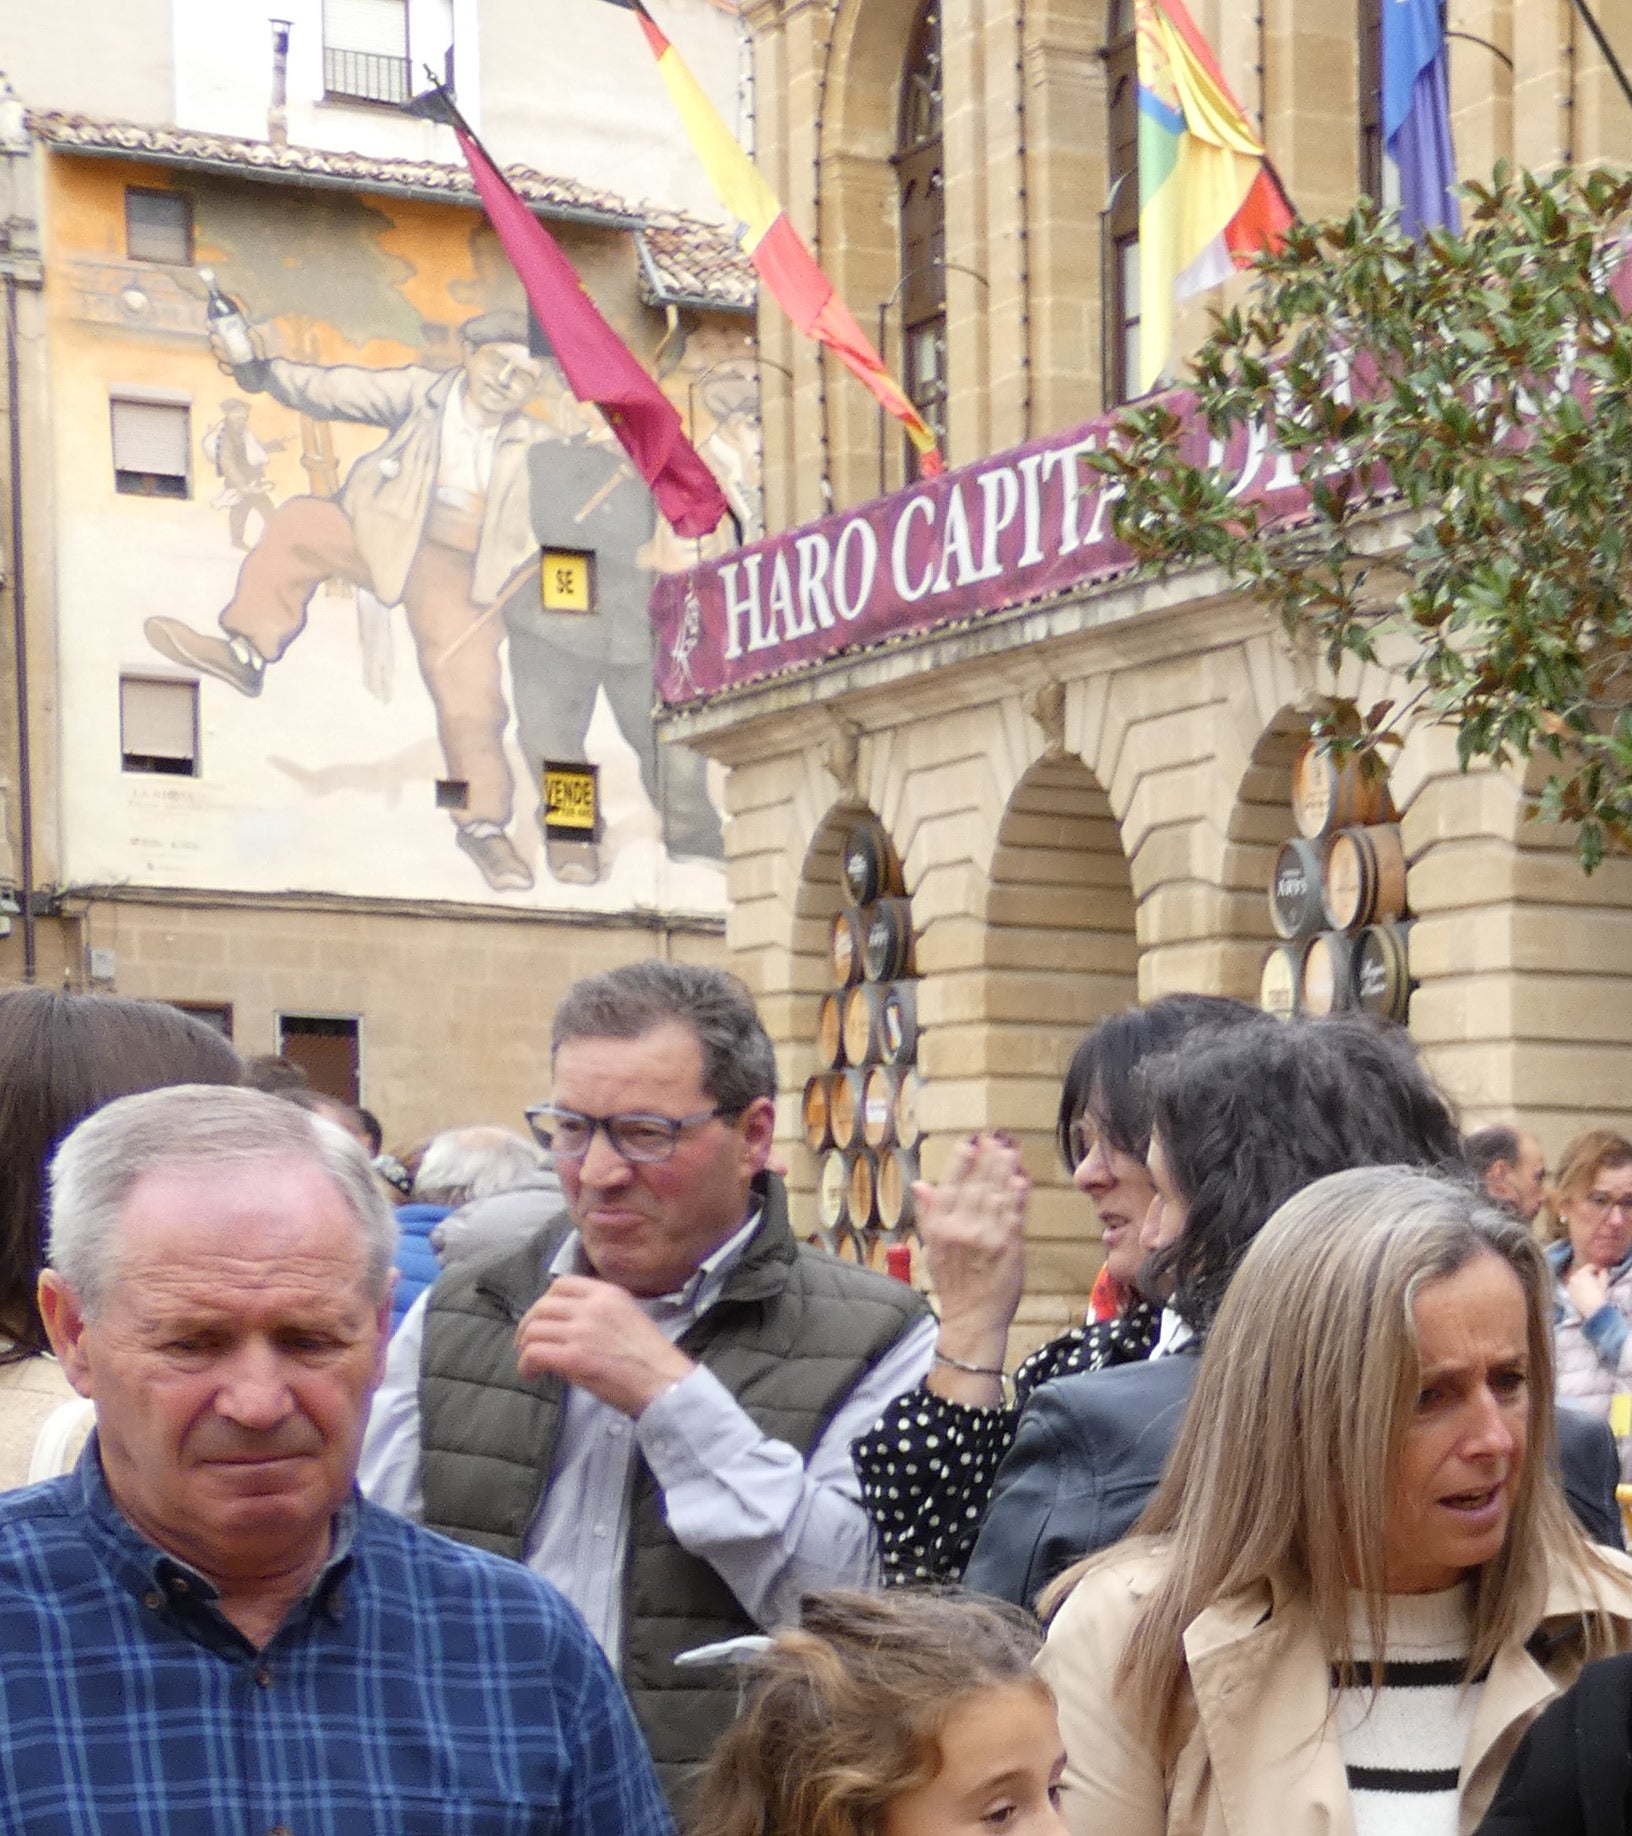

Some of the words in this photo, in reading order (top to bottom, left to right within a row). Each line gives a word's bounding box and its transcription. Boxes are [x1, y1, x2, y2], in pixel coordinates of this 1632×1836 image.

[555, 567, 575, 595] SE
[718, 517, 876, 660] HARO
[891, 433, 1125, 601] CAPITA
